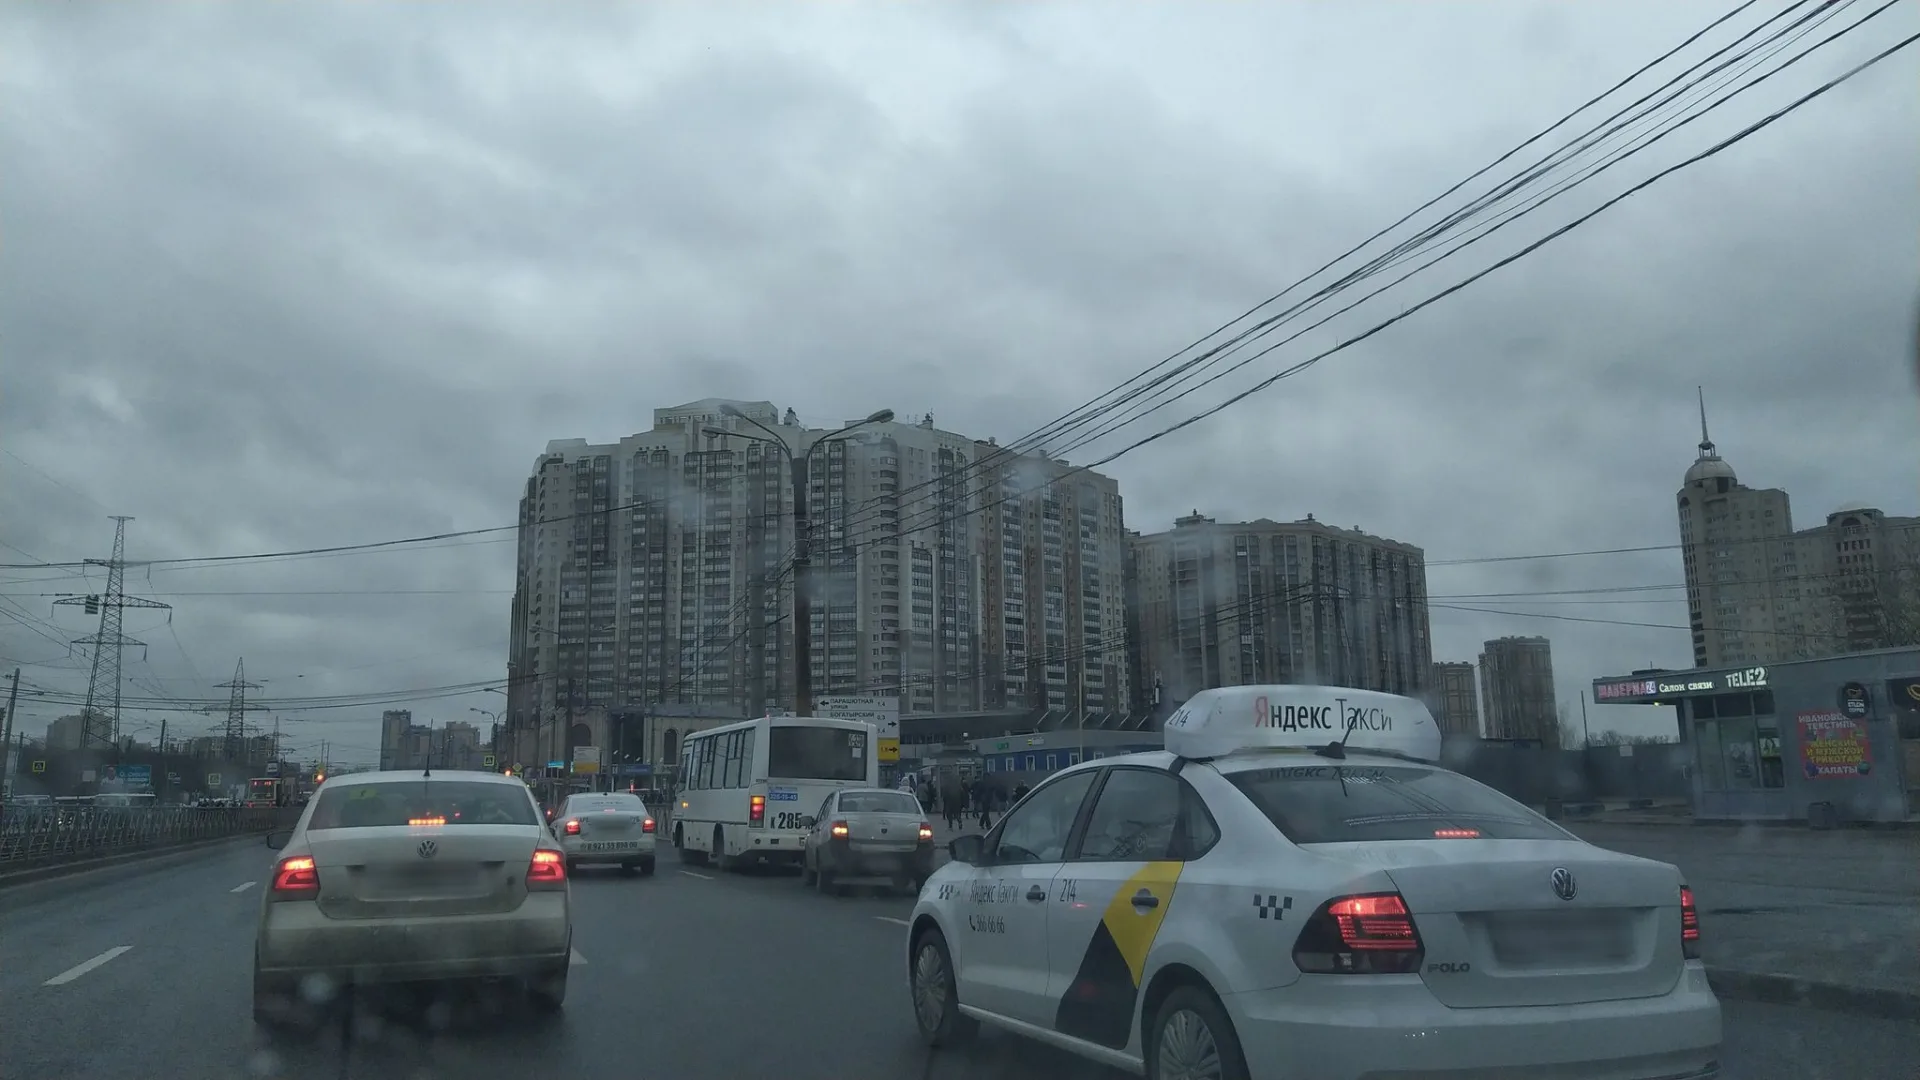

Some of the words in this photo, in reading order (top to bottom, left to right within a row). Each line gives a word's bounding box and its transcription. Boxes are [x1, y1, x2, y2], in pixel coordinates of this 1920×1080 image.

[1725, 667, 1767, 688] TELE2
[1659, 682, 1685, 693] Салон
[1688, 680, 1713, 690] связи
[1253, 696, 1332, 732] Яндекс
[1335, 698, 1392, 731] Такси
[1807, 721, 1857, 730] ТЕКСТИЛЬ
[1818, 765, 1858, 775] ХАЛАТЫ
[777, 812, 803, 829] 285
[968, 879, 996, 906] Яндекс
[998, 878, 1019, 904] Такси
[1060, 879, 1077, 902] 214
[1427, 962, 1470, 973] POLO
